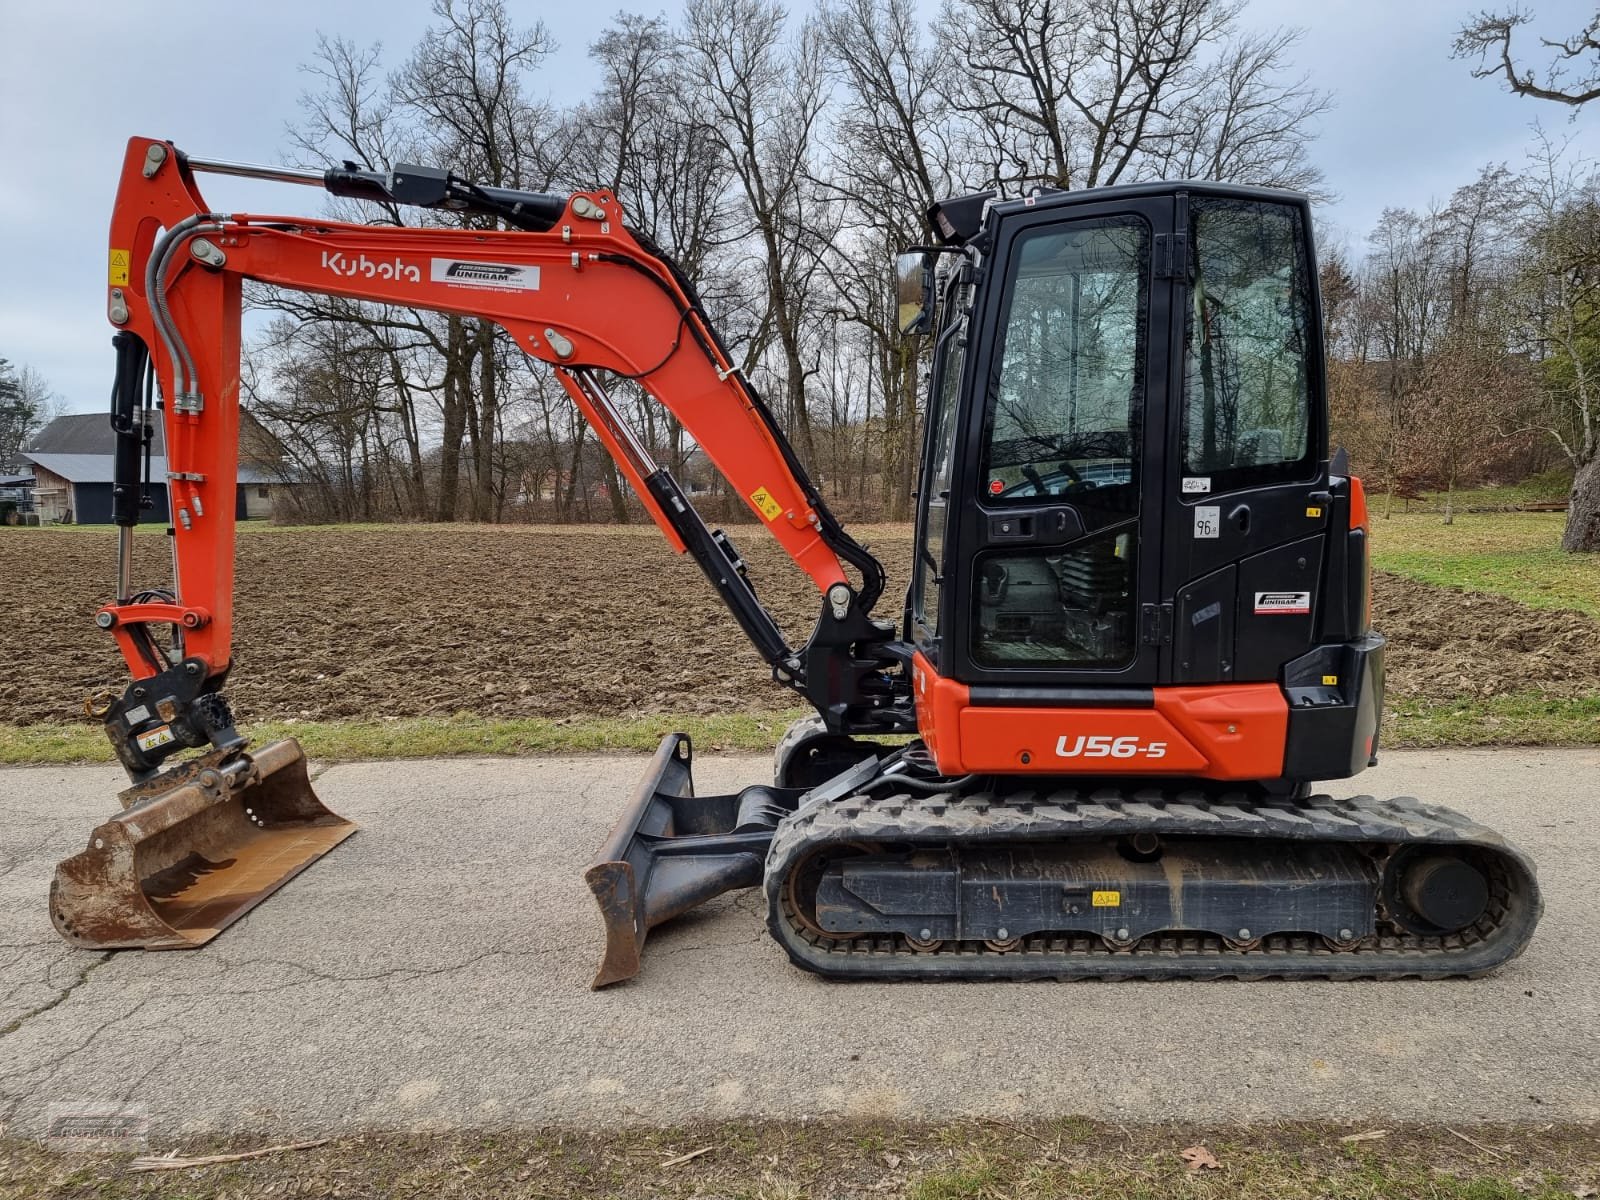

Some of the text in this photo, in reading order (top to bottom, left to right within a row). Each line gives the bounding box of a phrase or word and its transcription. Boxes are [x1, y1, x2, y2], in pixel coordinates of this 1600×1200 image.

[321, 251, 420, 283] Kubota
[1197, 520, 1211, 535] 96
[1055, 735, 1167, 758] U56-5
